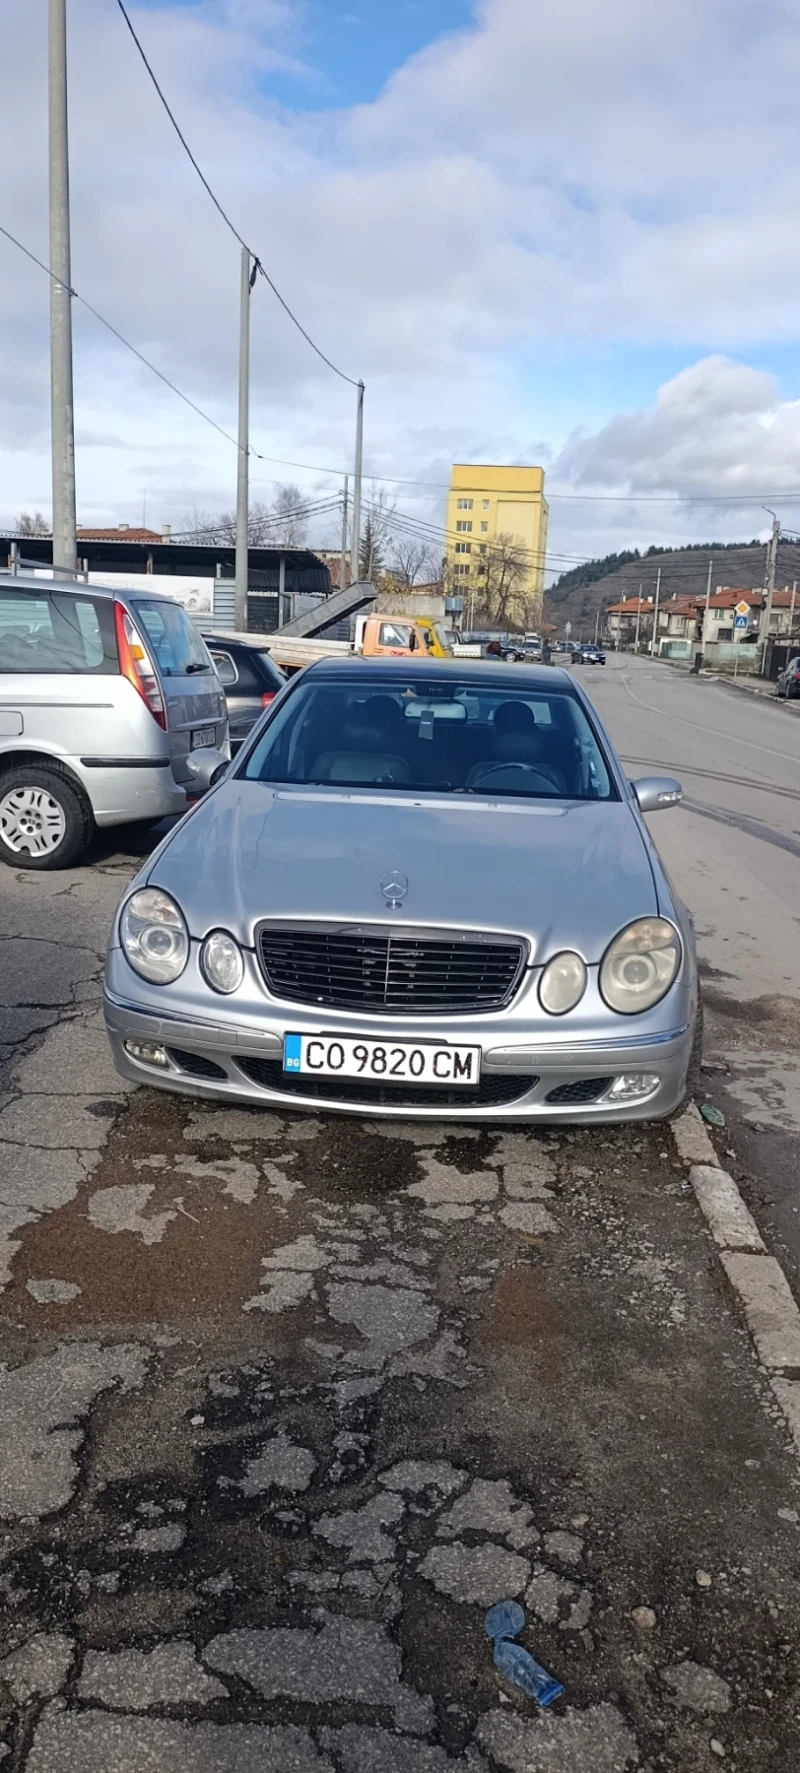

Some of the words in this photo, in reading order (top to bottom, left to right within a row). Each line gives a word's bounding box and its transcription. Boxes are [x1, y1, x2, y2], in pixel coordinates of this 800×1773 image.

[287, 1058, 299, 1067] BG
[306, 1041, 345, 1069] CO
[352, 1045, 426, 1076] 9820
[432, 1051, 473, 1079] CM
